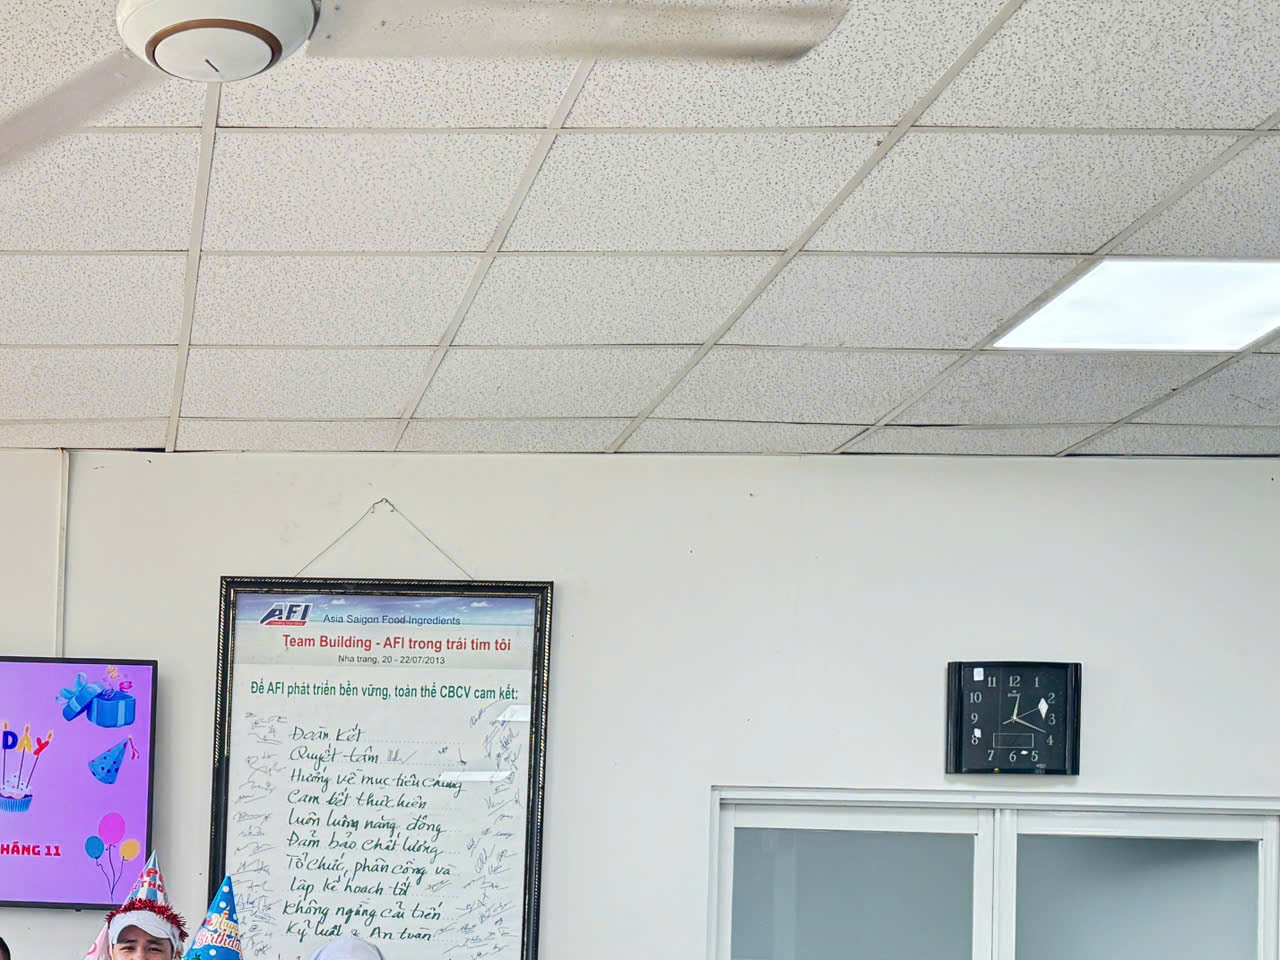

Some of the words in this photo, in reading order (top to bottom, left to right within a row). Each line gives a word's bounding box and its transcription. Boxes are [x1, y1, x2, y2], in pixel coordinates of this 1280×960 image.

[260, 603, 311, 624] AFI
[323, 614, 344, 623] Asia
[346, 615, 379, 625] Saigon
[382, 615, 406, 624] Food
[408, 616, 461, 626] Ingredients
[282, 634, 315, 648] Team
[320, 635, 372, 651] Building
[383, 637, 404, 649] AFI
[408, 639, 442, 652] trong
[446, 638, 466, 650] trái
[471, 638, 490, 650] tim
[495, 638, 511, 651] tôi
[338, 655, 355, 663] Nha
[400, 656, 445, 664] 22/07/2013
[987, 676, 996, 687] 11
[1009, 675, 1021, 687] 12
[1034, 676, 1039, 687] 1
[251, 678, 264, 694] Để
[267, 681, 284, 694] AFI
[287, 682, 310, 697] phát
[313, 680, 336, 696] triển
[339, 680, 358, 696] bền
[395, 684, 417, 698] toàn
[420, 682, 437, 698] thể
[440, 685, 472, 699] CBCV
[474, 688, 496, 699] cam
[499, 684, 518, 700] kết:
[969, 691, 982, 703] 10
[1047, 692, 1056, 704] 2
[971, 713, 979, 724] 9
[1048, 713, 1056, 725] 3
[1047, 734, 1054, 746] 4
[987, 749, 995, 761] 7
[1009, 751, 1017, 762] 6
[1031, 750, 1038, 762] 5
[288, 789, 320, 805] Cam
[44, 845, 62, 857] 11
